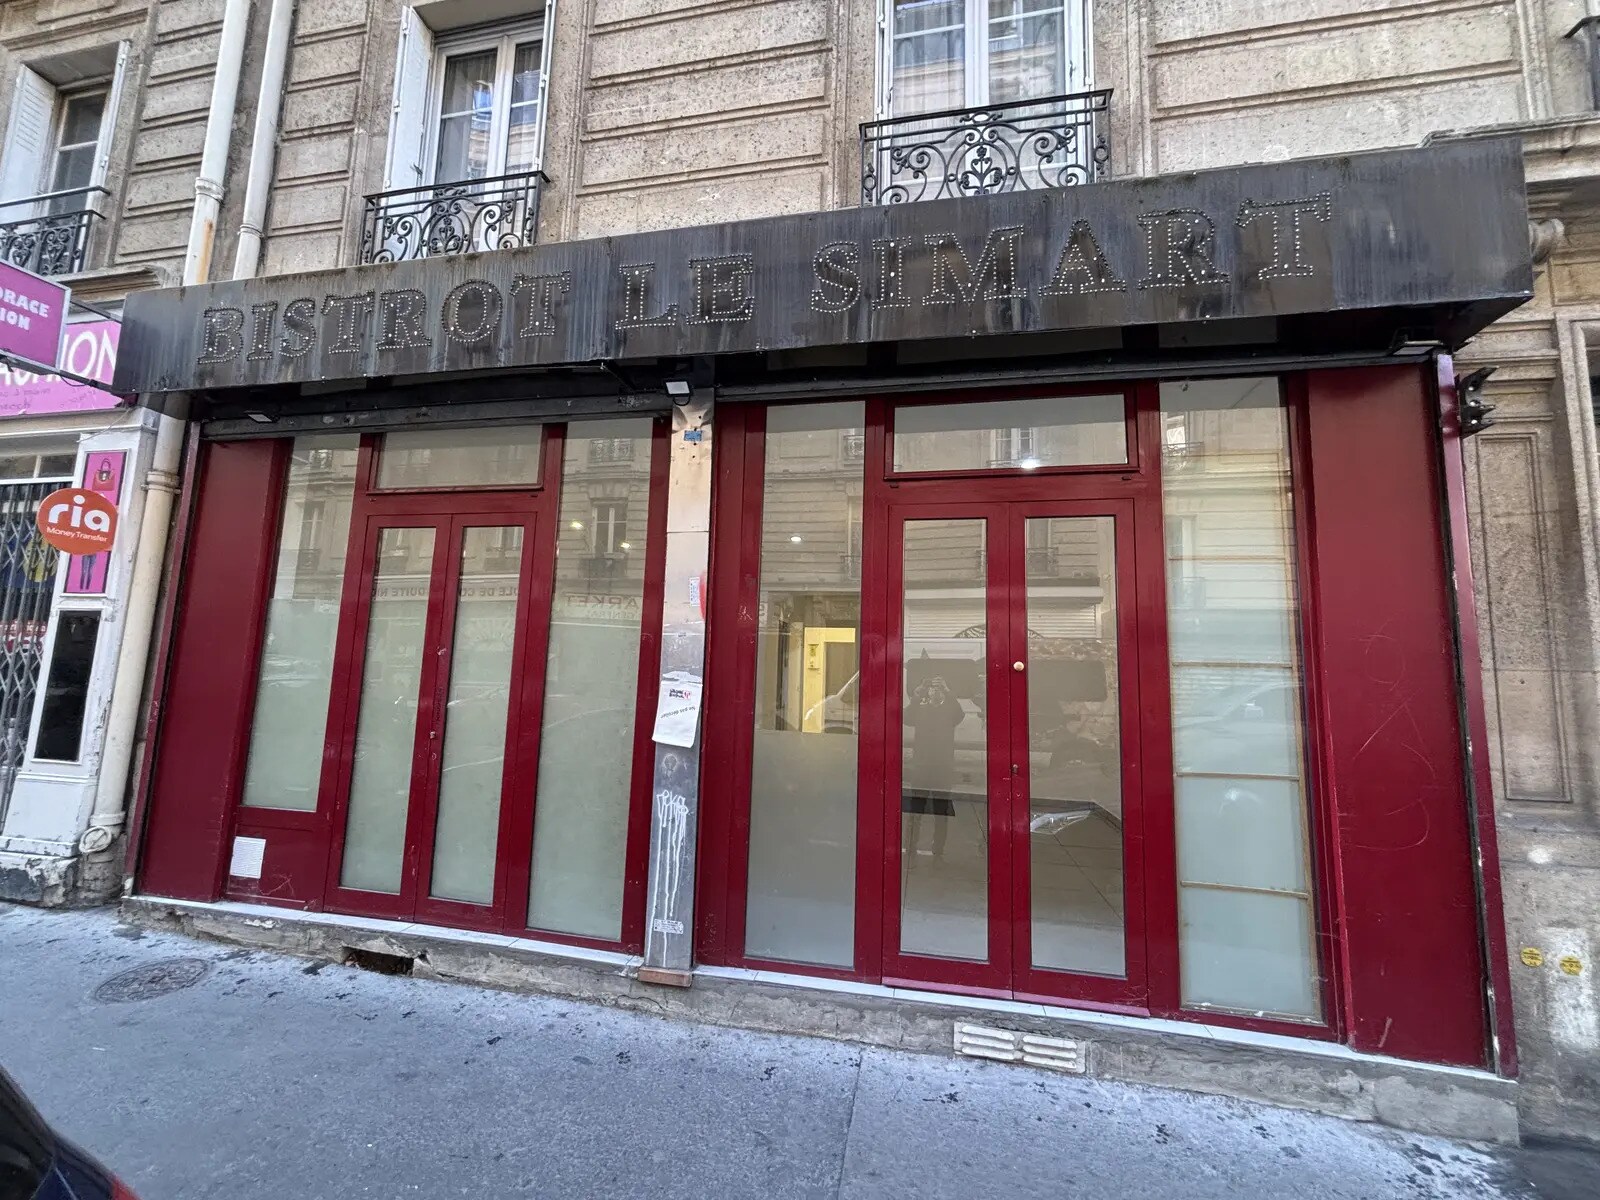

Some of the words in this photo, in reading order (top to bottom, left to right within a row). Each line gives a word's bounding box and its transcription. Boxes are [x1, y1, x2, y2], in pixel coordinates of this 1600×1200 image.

[197, 269, 571, 364] BISTROT
[614, 253, 756, 330] LE
[811, 190, 1331, 314] SIMART
[48, 495, 110, 532] ria
[47, 526, 76, 539] Money
[76, 531, 108, 542] Transfer
